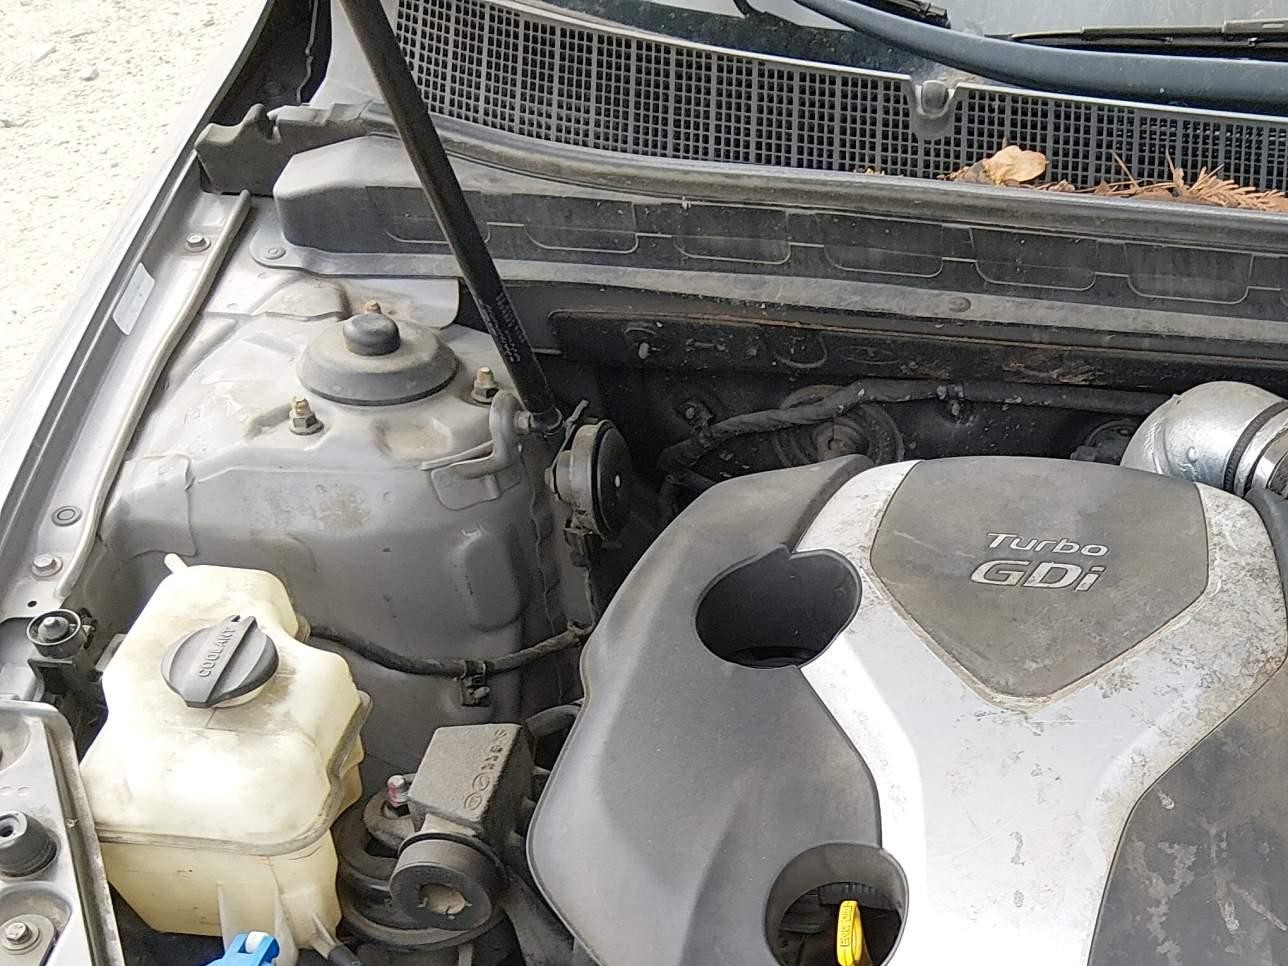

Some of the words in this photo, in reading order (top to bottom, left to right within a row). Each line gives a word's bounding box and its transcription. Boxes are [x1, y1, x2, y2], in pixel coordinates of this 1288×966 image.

[986, 532, 1109, 556] Turbo
[970, 560, 1106, 592] GDi
[198, 627, 236, 678] COOLANT
